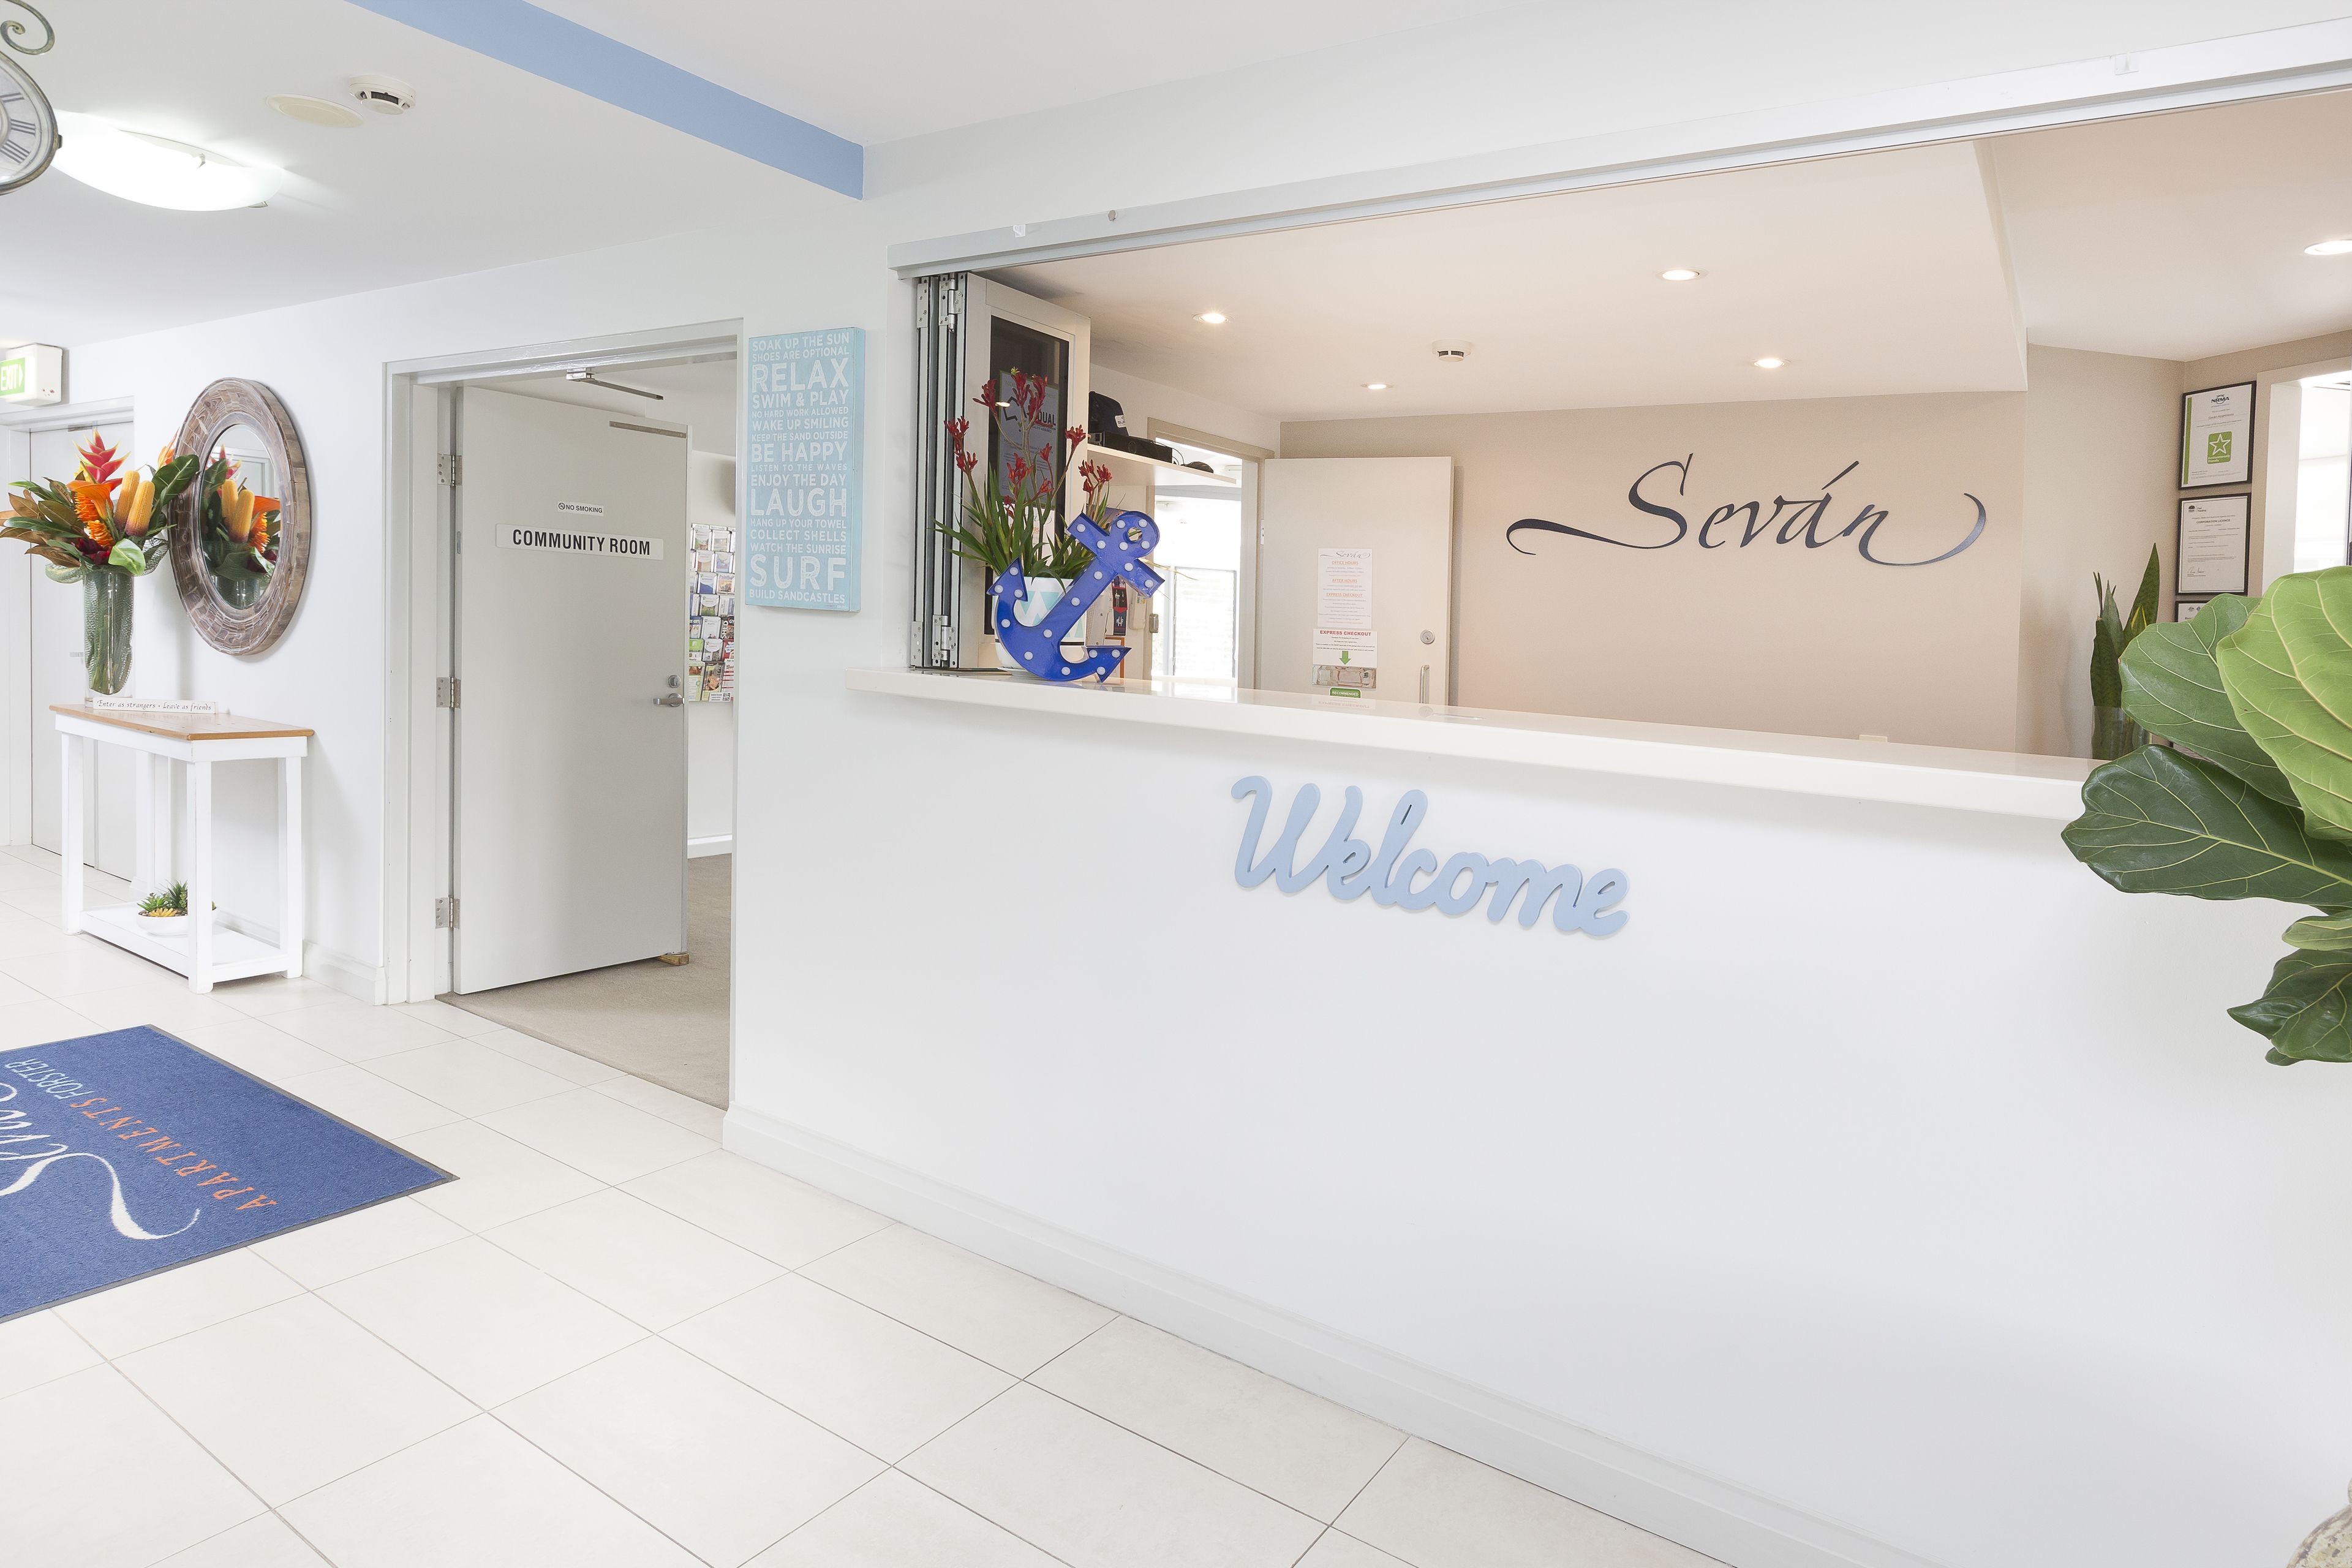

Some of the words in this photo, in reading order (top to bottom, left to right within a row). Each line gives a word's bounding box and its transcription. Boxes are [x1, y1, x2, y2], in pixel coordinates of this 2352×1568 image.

[752, 339, 782, 352] SOAK
[785, 337, 799, 349] UP
[802, 334, 823, 347] THE
[827, 332, 849, 345] SUN
[752, 352, 780, 363] SHOES
[783, 350, 800, 360] ARE
[803, 345, 849, 358] OPTIONAL
[1, 363, 19, 391] EXIT
[752, 357, 849, 393] RELAX
[752, 393, 791, 409] SWIM
[796, 392, 804, 407] &
[810, 389, 849, 406] PLAY
[786, 408, 809, 417] WORK
[811, 406, 848, 415] ALLOWED
[752, 420, 783, 431] WAKE
[787, 419, 801, 430] UP
[804, 417, 849, 429] SMILING
[790, 432, 810, 441] SAND
[813, 431, 848, 440] OUTSIDE
[751, 443, 774, 462] BE
[782, 440, 848, 462] HAPPY
[751, 473, 790, 486] ENJOY
[793, 473, 816, 486] THE
[821, 473, 846, 486] DAY
[750, 488, 846, 517] LAUGH
[1506, 453, 1987, 567] Seván
[750, 518, 773, 527] HANG
[790, 519, 812, 528] YOUR
[814, 519, 846, 529] TOWEL
[513, 529, 605, 552] COMMUNITY
[609, 538, 650, 556] ROOM
[750, 529, 799, 540] COLLECT
[804, 530, 846, 541] SHELLS
[750, 543, 783, 552] WATCH
[786, 543, 804, 553] THE
[806, 544, 846, 554] SUNRISE
[750, 553, 846, 590] SURF
[749, 589, 775, 599] BUILD
[778, 590, 845, 604] SANDCASTLES
[127, 702, 156, 710] strangers
[190, 702, 211, 712] friends
[1231, 775, 1630, 936] Welcome
[5, 1058, 94, 1099] FORSTER
[69, 1097, 279, 1211] APARTMENTS
